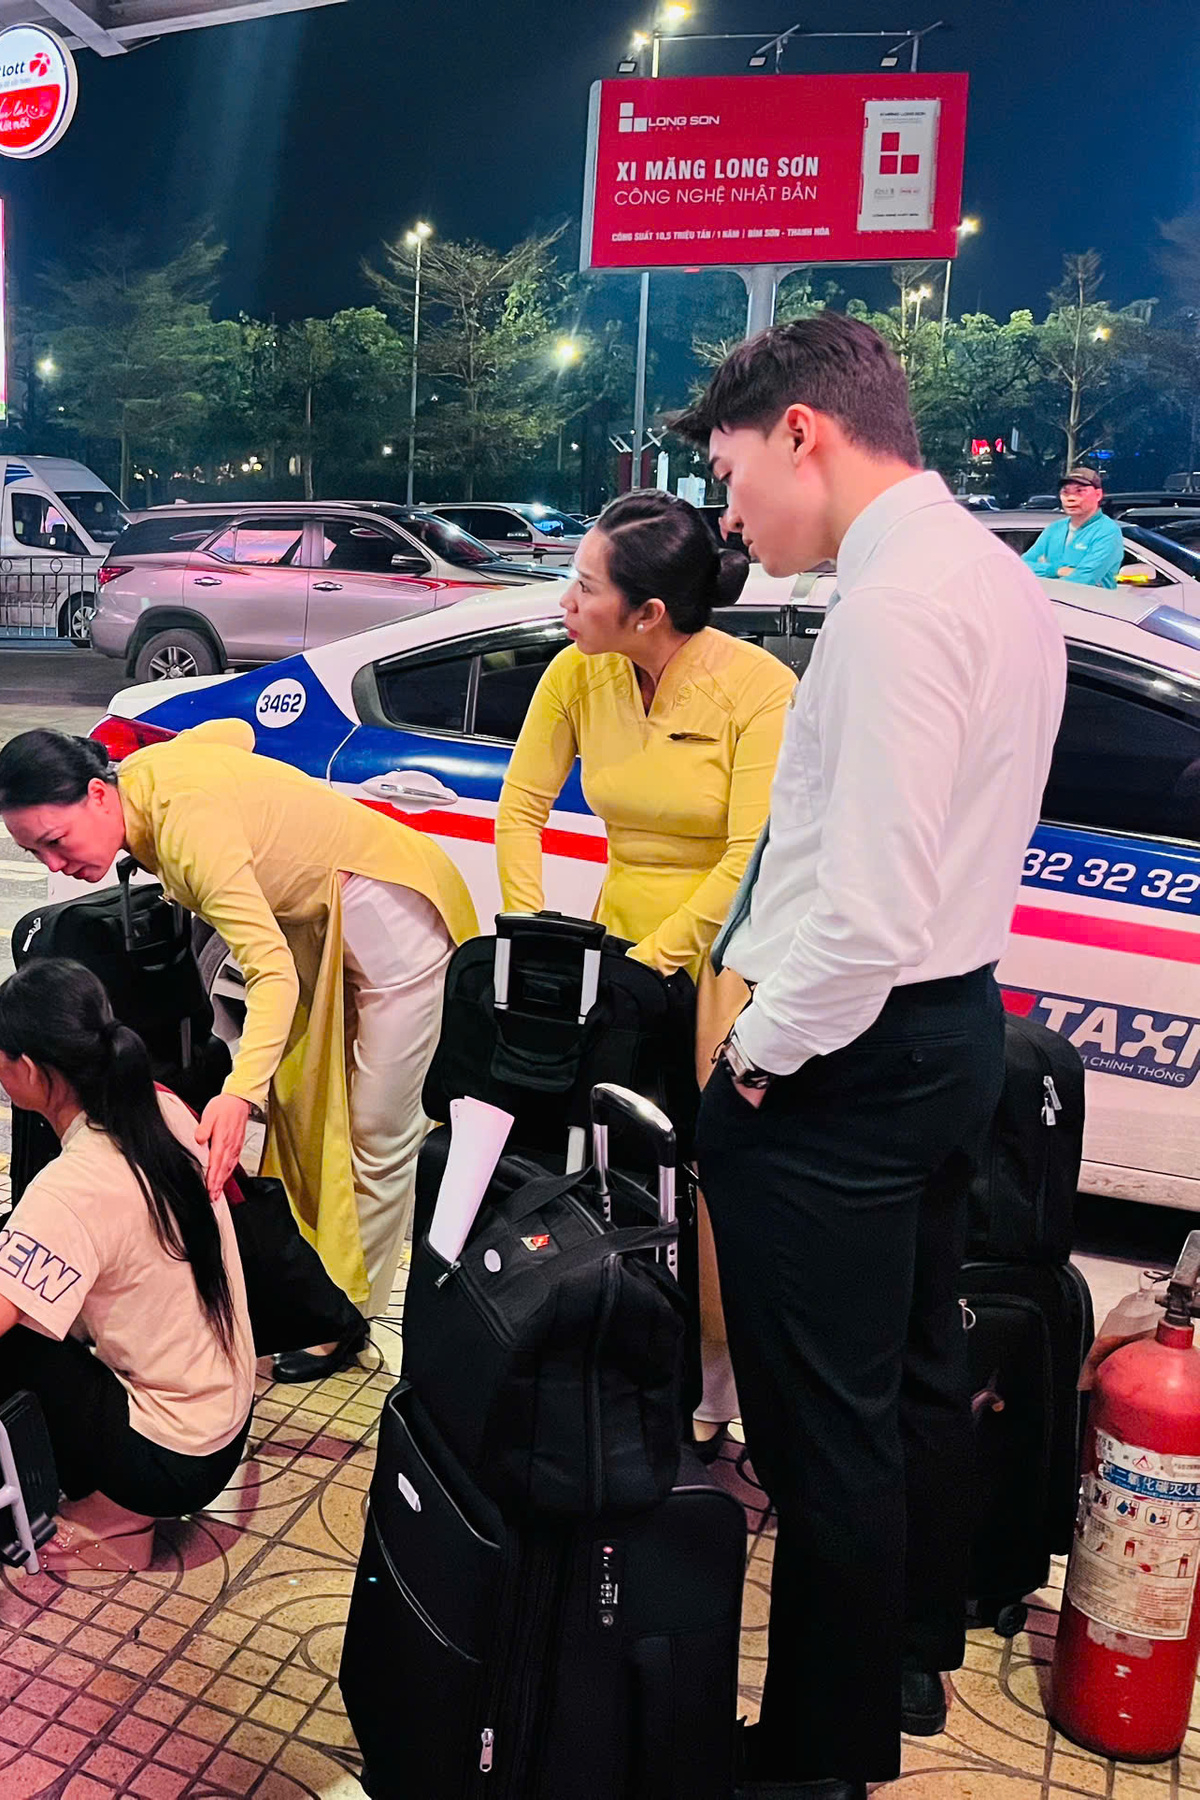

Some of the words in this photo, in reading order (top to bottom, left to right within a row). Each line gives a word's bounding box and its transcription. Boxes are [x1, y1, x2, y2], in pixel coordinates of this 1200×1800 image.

[648, 116, 687, 127] LONG
[616, 161, 636, 182] XI
[645, 156, 706, 181] MĂNG
[714, 158, 769, 179] LONG
[777, 154, 819, 177] SƠN
[614, 187, 670, 206] CÔNG
[676, 185, 725, 205] NGHỆ
[731, 185, 777, 204] NHẬT
[781, 182, 817, 200] BẢN
[259, 693, 302, 713] 3462
[1021, 848, 1073, 882] 32
[1077, 858, 1137, 893] 32
[1140, 868, 1200, 904] 32
[1039, 997, 1200, 1069] TAXI
[1090, 1057, 1134, 1073] CHÍNH
